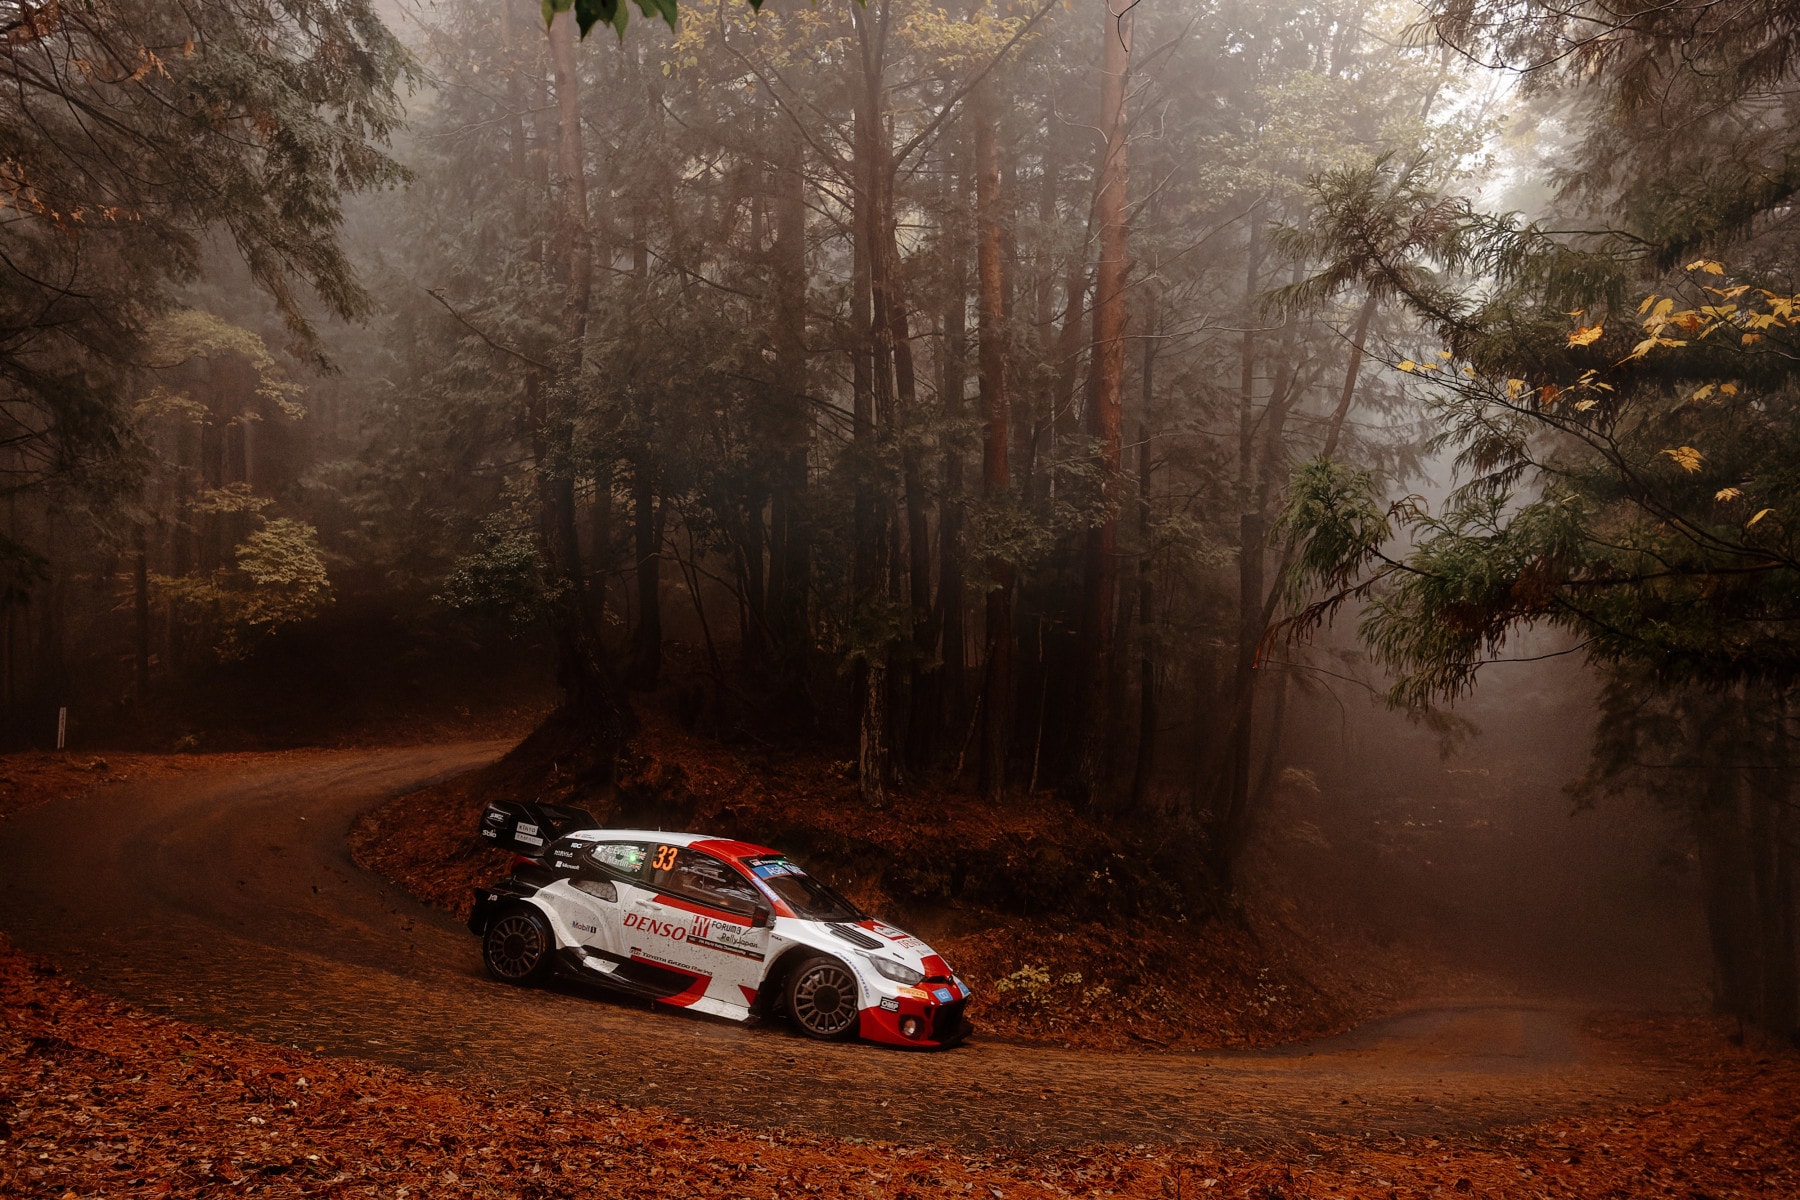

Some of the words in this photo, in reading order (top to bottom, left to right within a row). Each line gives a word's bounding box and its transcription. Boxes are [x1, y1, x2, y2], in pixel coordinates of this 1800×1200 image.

[652, 845, 678, 871] 33
[572, 921, 590, 932] Mobil
[623, 913, 687, 941] DENSO
[667, 959, 691, 969] GAZOO
[881, 999, 899, 1010] OMP
